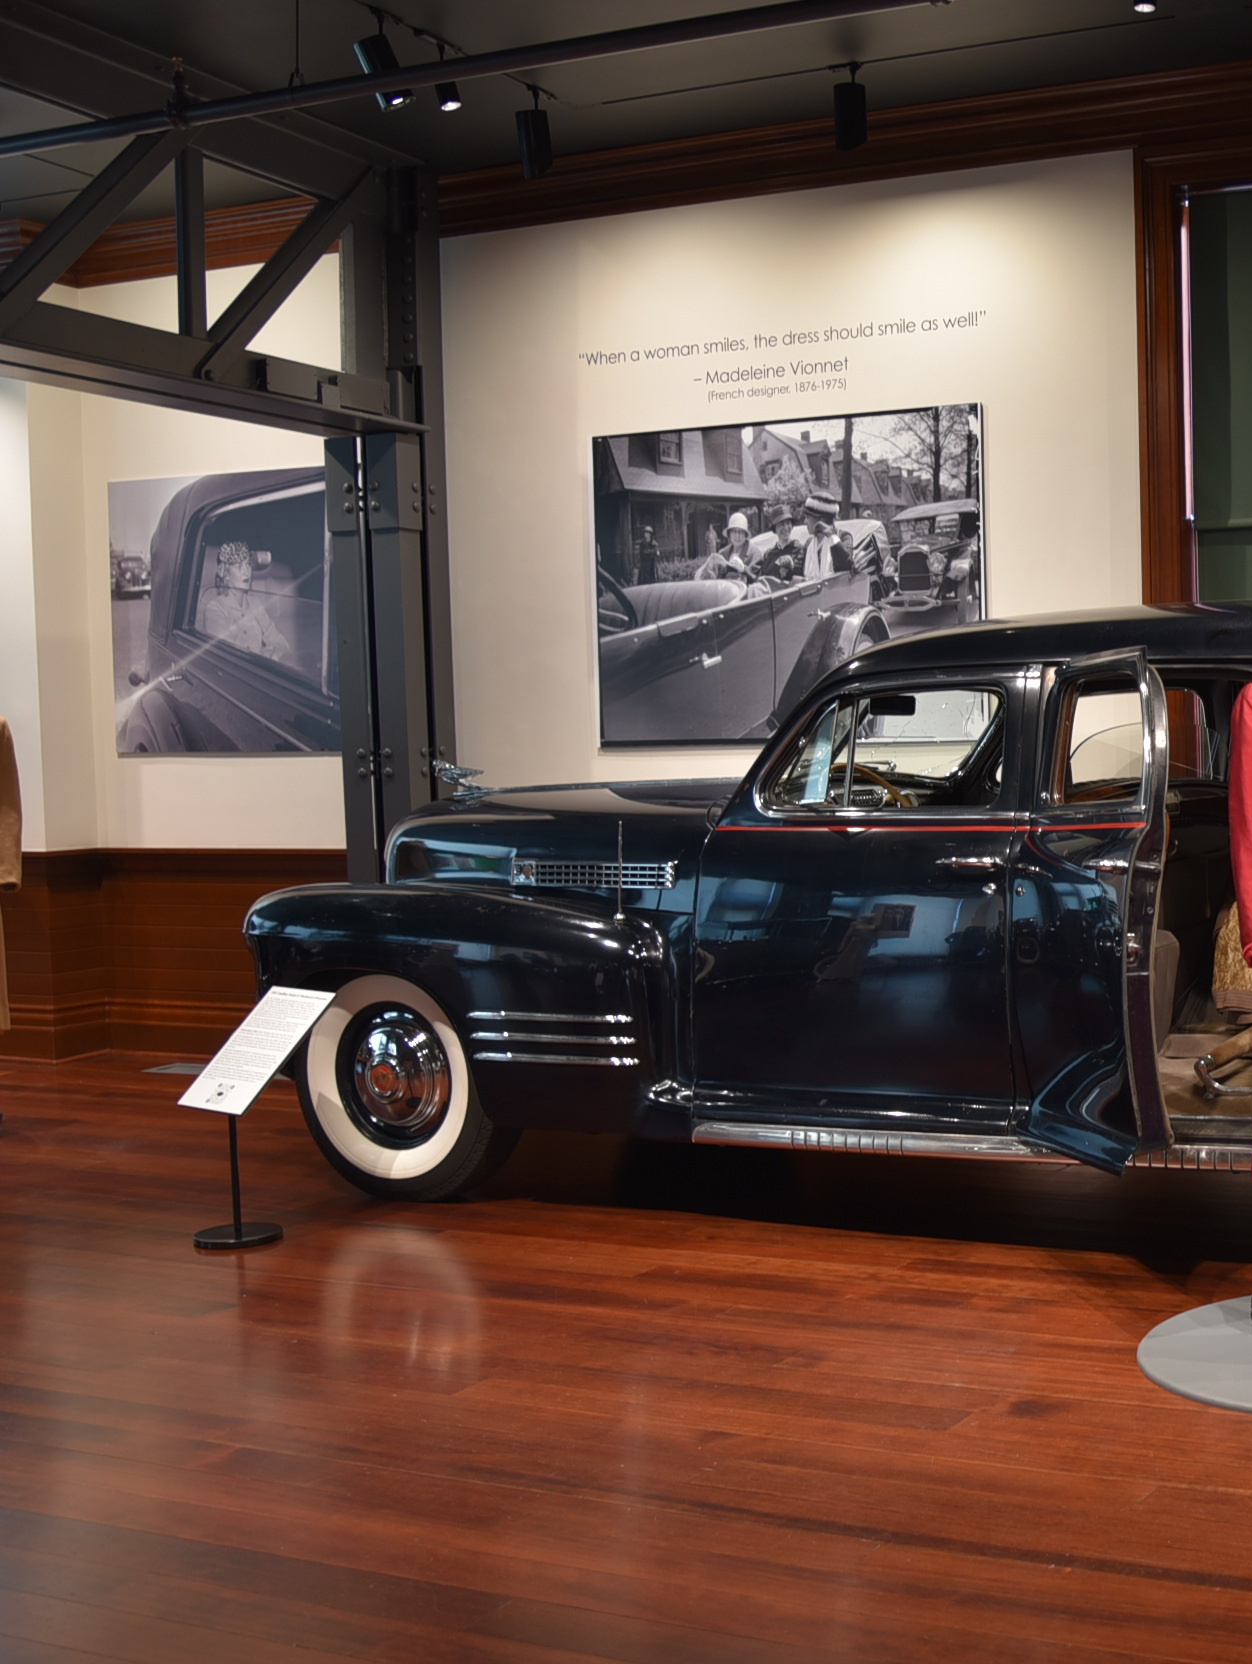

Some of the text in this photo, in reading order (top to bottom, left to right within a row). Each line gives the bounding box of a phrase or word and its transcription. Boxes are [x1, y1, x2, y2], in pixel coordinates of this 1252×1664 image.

[578, 350, 626, 366] “When
[630, 350, 640, 363] a
[644, 343, 699, 360] woman
[703, 337, 749, 355] smiles,
[753, 333, 778, 349] the
[782, 330, 820, 346] dress
[823, 322, 874, 342] should
[878, 318, 916, 336] smile
[921, 318, 939, 332] as
[705, 364, 786, 385] Madeleine
[790, 356, 849, 376] Vionnet
[707, 378, 847, 404] (French designer, 1876-1975)
